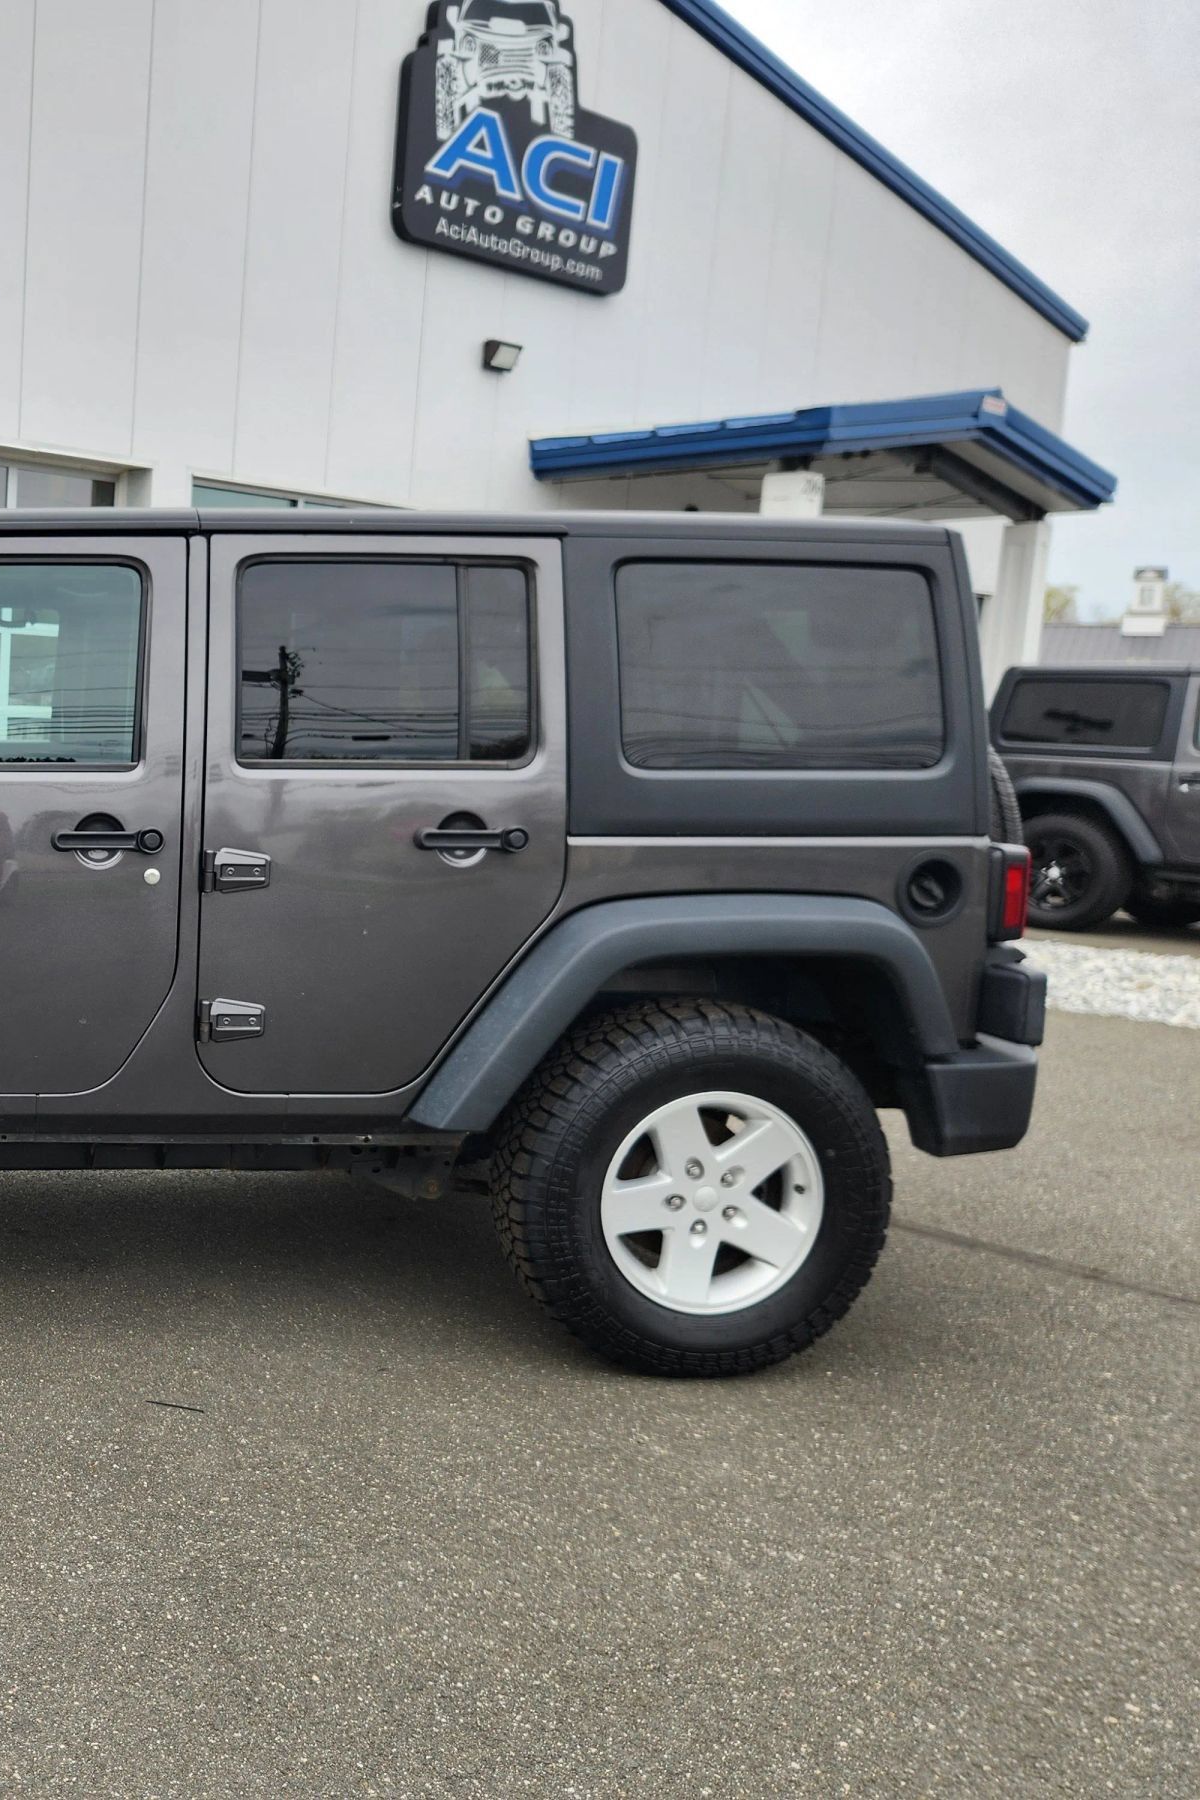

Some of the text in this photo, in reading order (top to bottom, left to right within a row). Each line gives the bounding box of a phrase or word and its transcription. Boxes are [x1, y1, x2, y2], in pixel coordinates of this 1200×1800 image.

[425, 106, 624, 230] ACI
[414, 184, 619, 260] AUTO GROUP
[434, 216, 604, 282] AciAutoGroup.com
